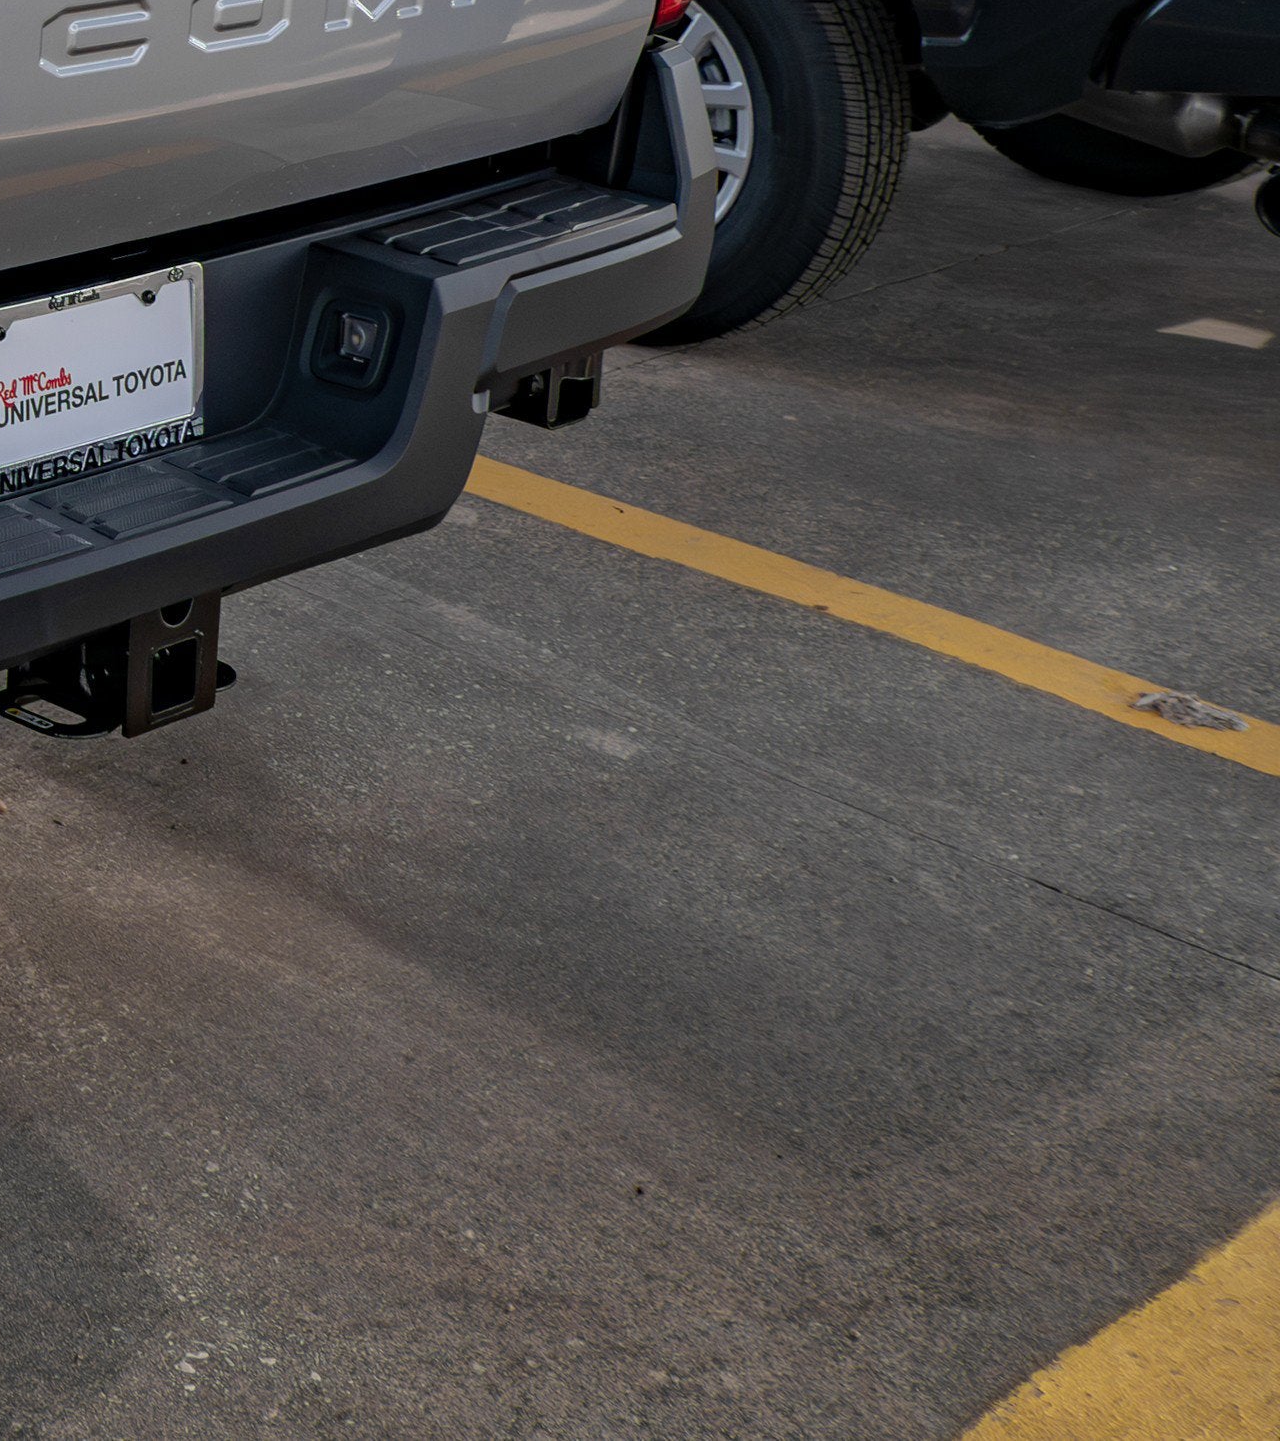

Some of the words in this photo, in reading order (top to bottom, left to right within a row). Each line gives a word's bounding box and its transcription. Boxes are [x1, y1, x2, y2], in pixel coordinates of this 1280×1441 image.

[19, 367, 72, 395] McCombs
[113, 359, 187, 397] TOYOTA
[114, 418, 196, 461] TOYOTA
